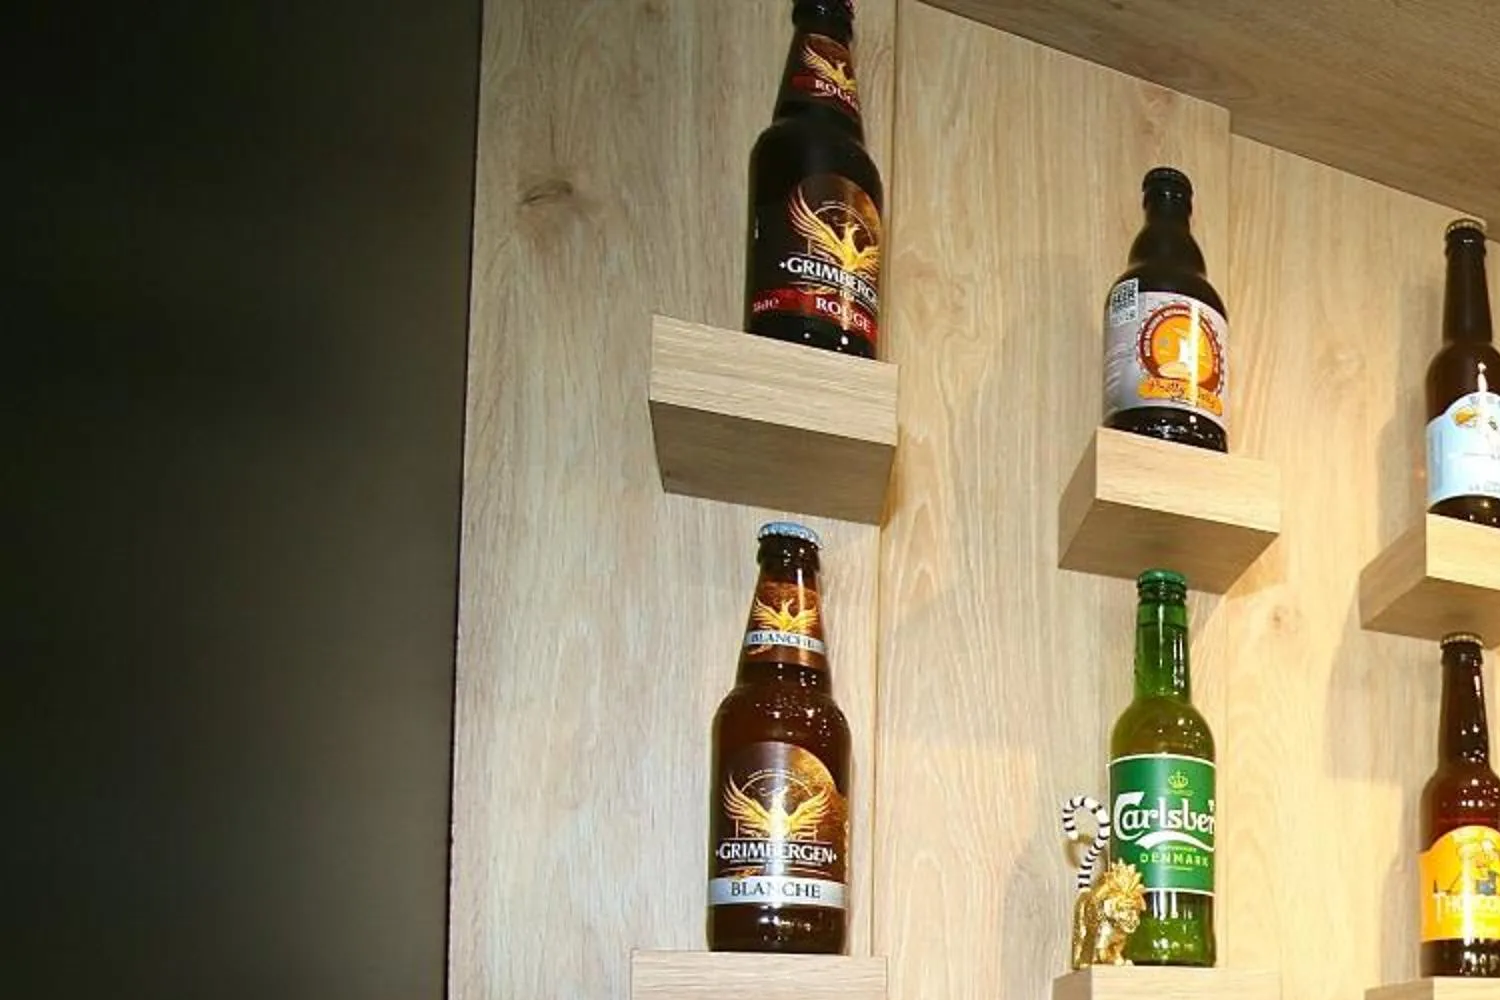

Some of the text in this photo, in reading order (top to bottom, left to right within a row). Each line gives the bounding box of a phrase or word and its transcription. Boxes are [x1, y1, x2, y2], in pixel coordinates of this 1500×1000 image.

[815, 79, 859, 110] ROU
[786, 256, 879, 306] GRIMBERG
[1113, 790, 1216, 842] Carlsber
[719, 842, 834, 864] GRIMBERGEN
[1139, 852, 1209, 868] DENMARK
[730, 881, 822, 899] BLANCHE
